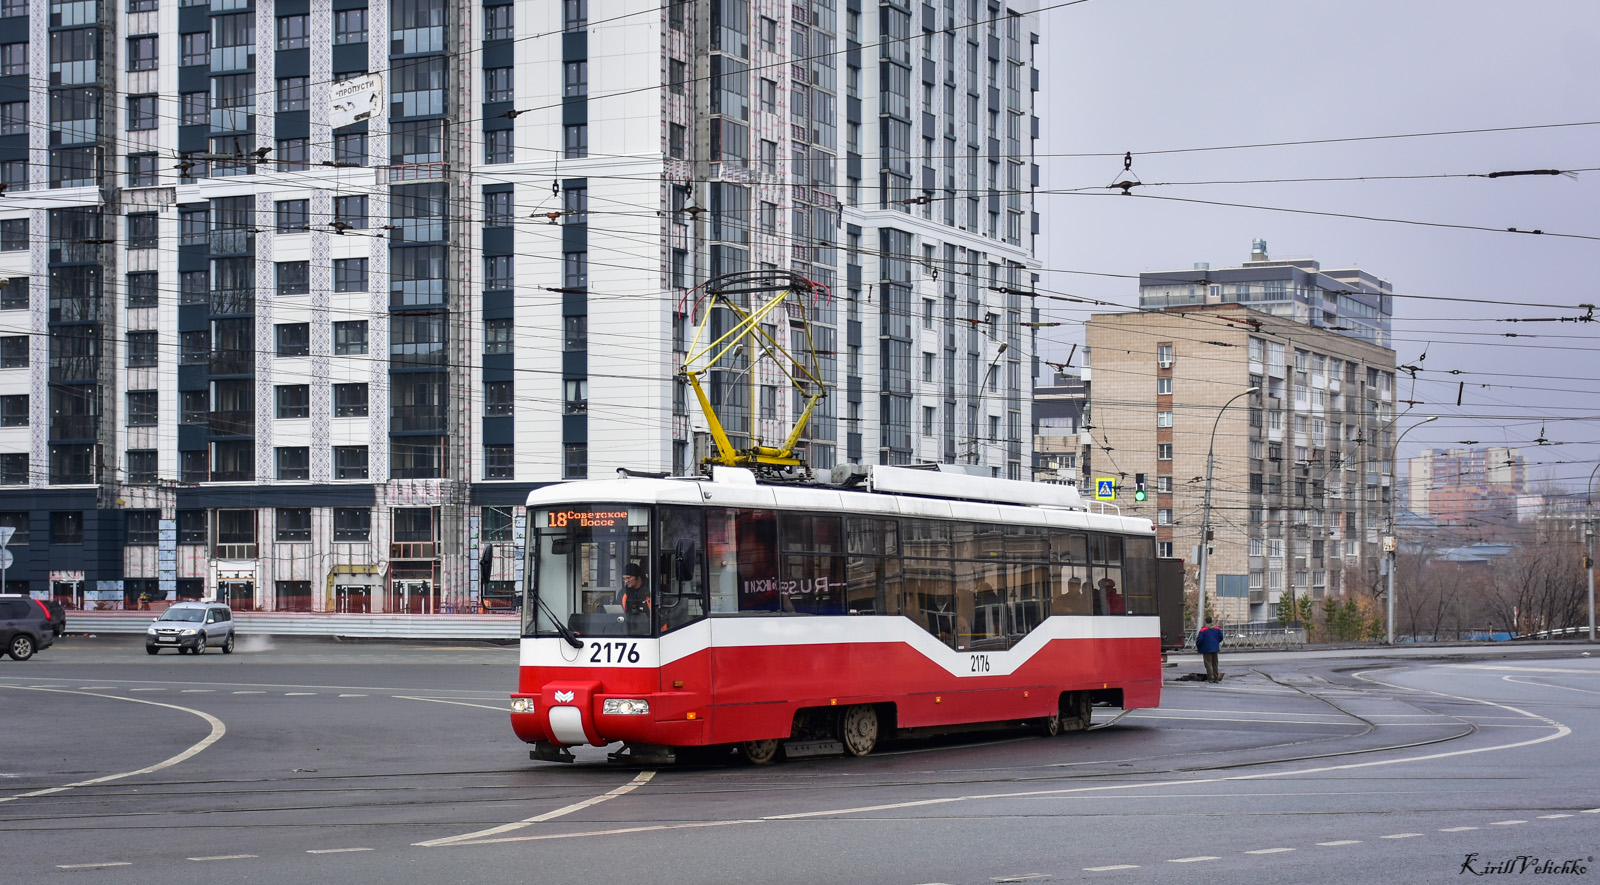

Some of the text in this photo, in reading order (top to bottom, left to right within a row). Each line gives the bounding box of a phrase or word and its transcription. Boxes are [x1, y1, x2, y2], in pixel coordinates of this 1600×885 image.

[549, 511, 568, 527] 18
[568, 510, 628, 519] Советское
[590, 642, 640, 664] 2176
[971, 654, 990, 672] 2176
